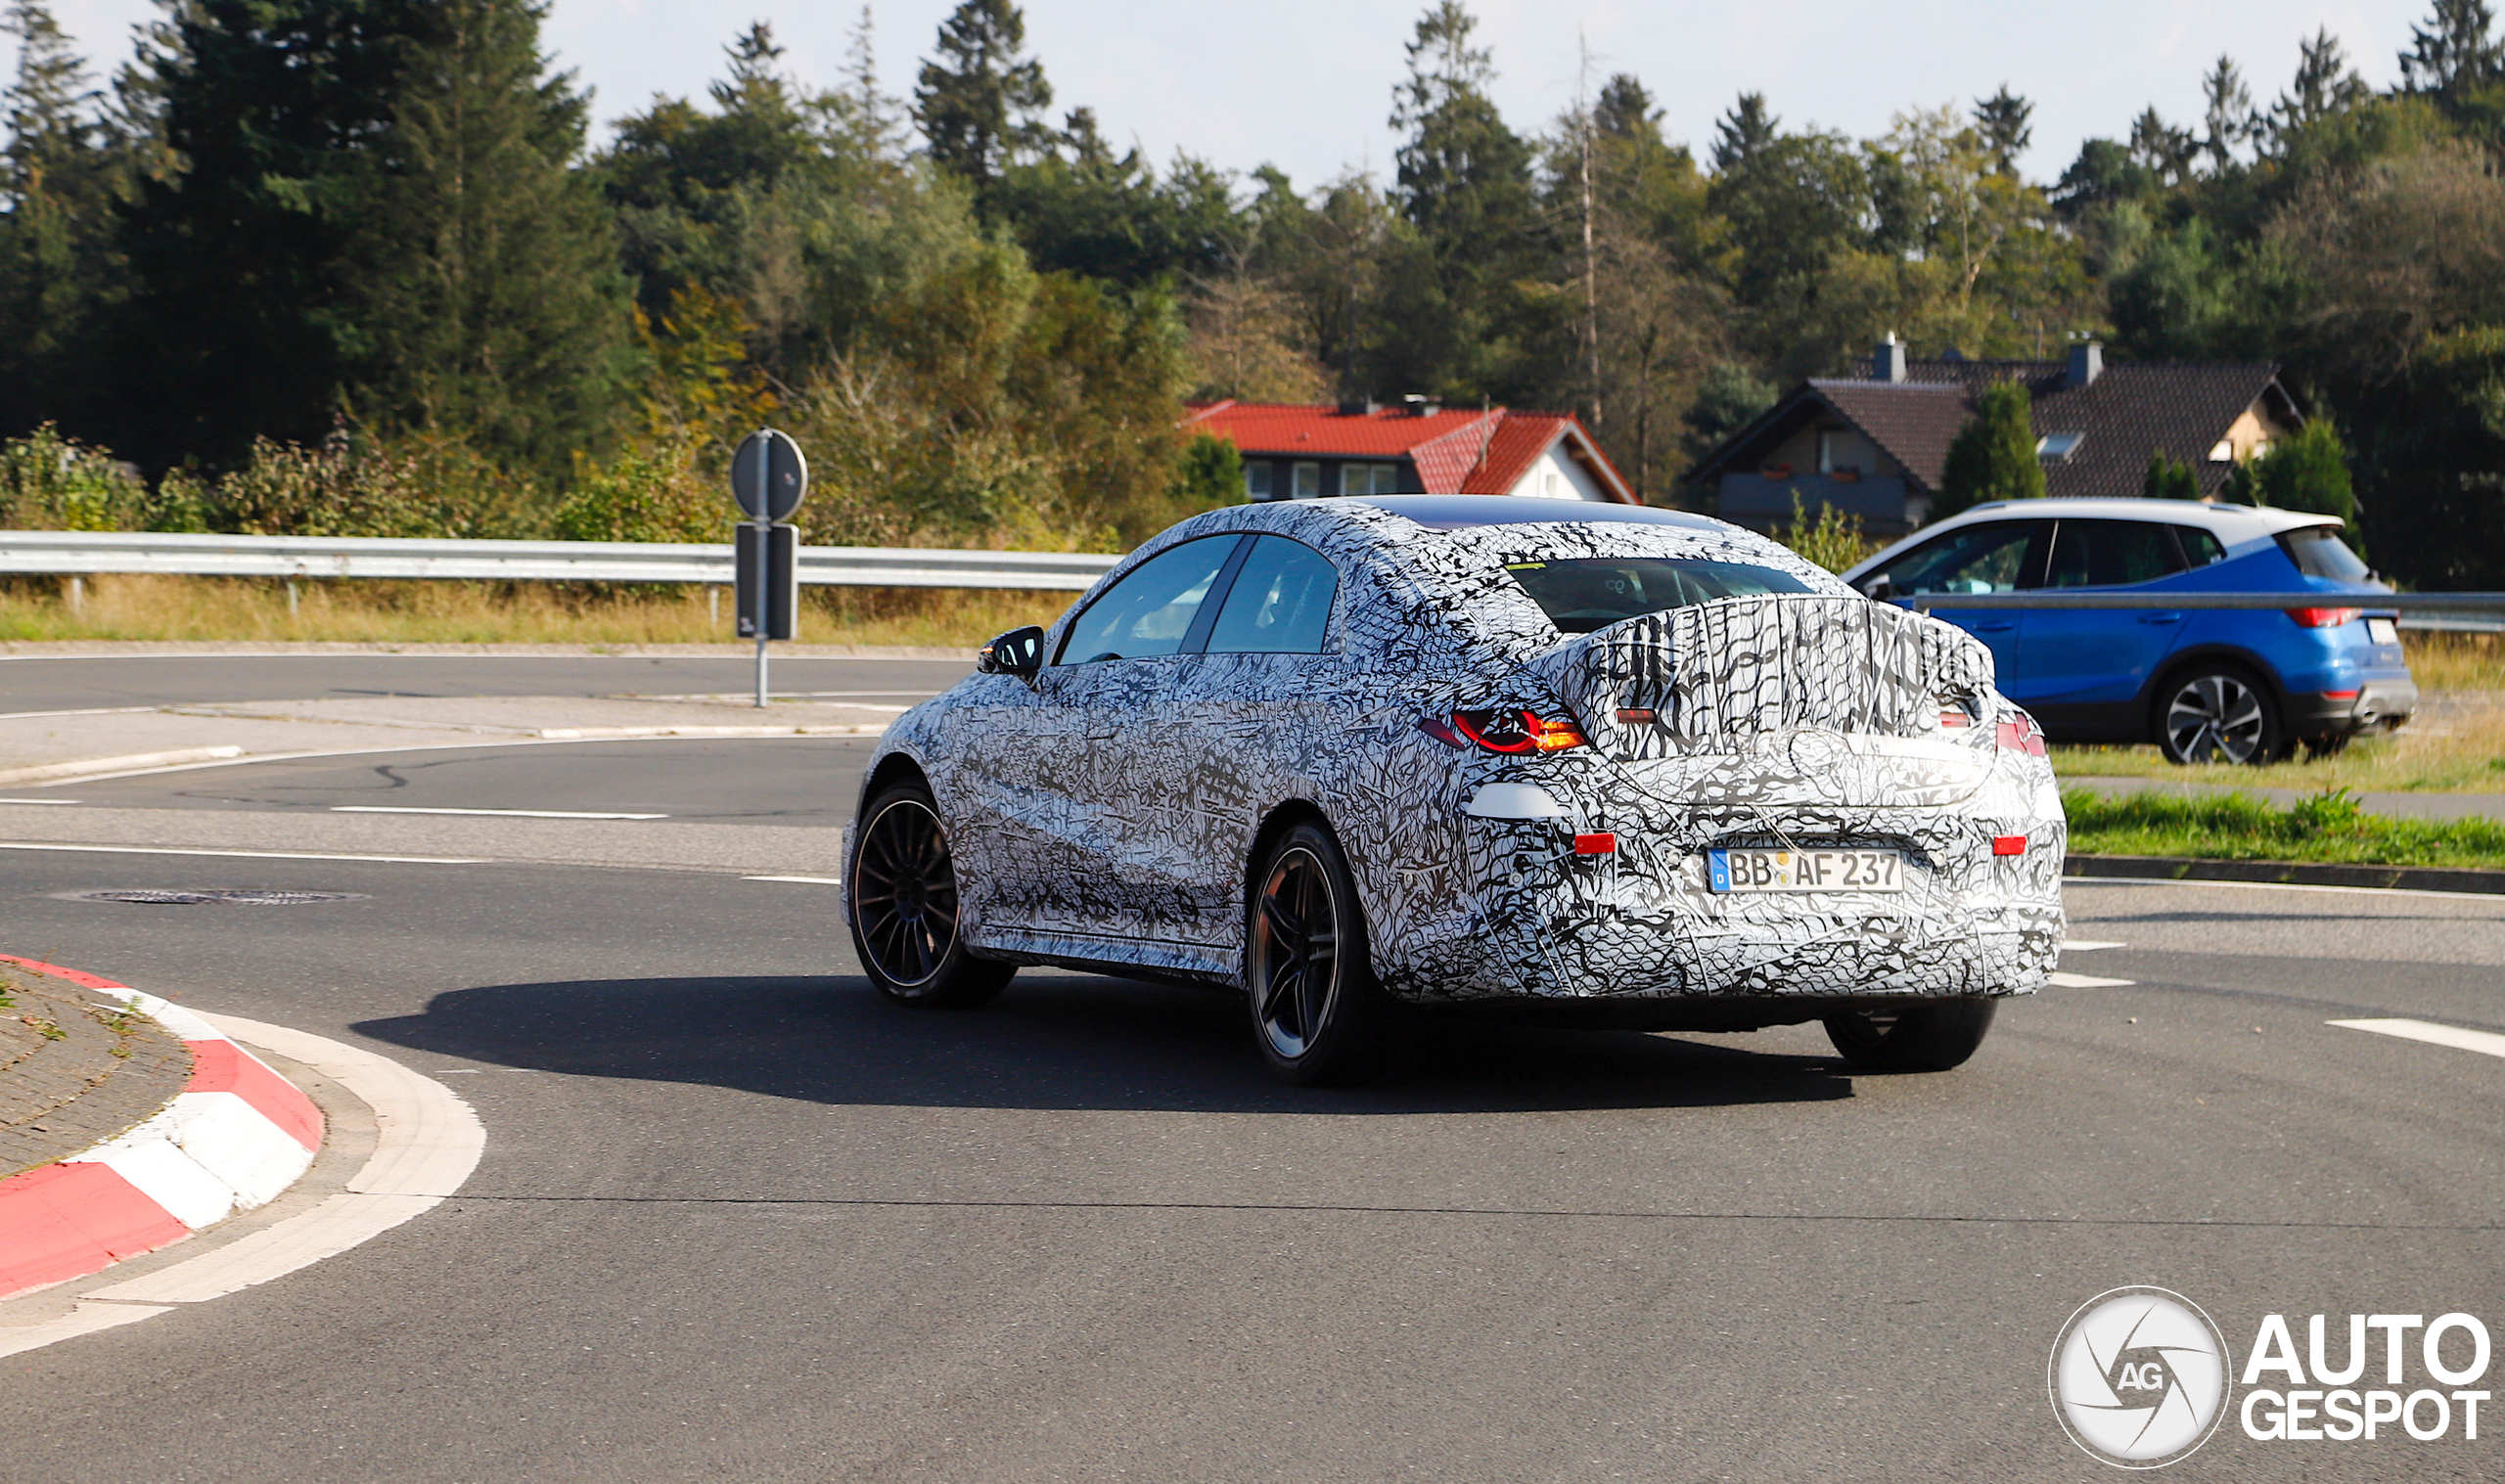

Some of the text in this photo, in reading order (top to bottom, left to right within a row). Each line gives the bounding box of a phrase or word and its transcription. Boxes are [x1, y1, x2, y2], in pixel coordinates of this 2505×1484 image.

[1716, 874, 1725, 884] D
[1730, 853, 1898, 885] BB AF 237
